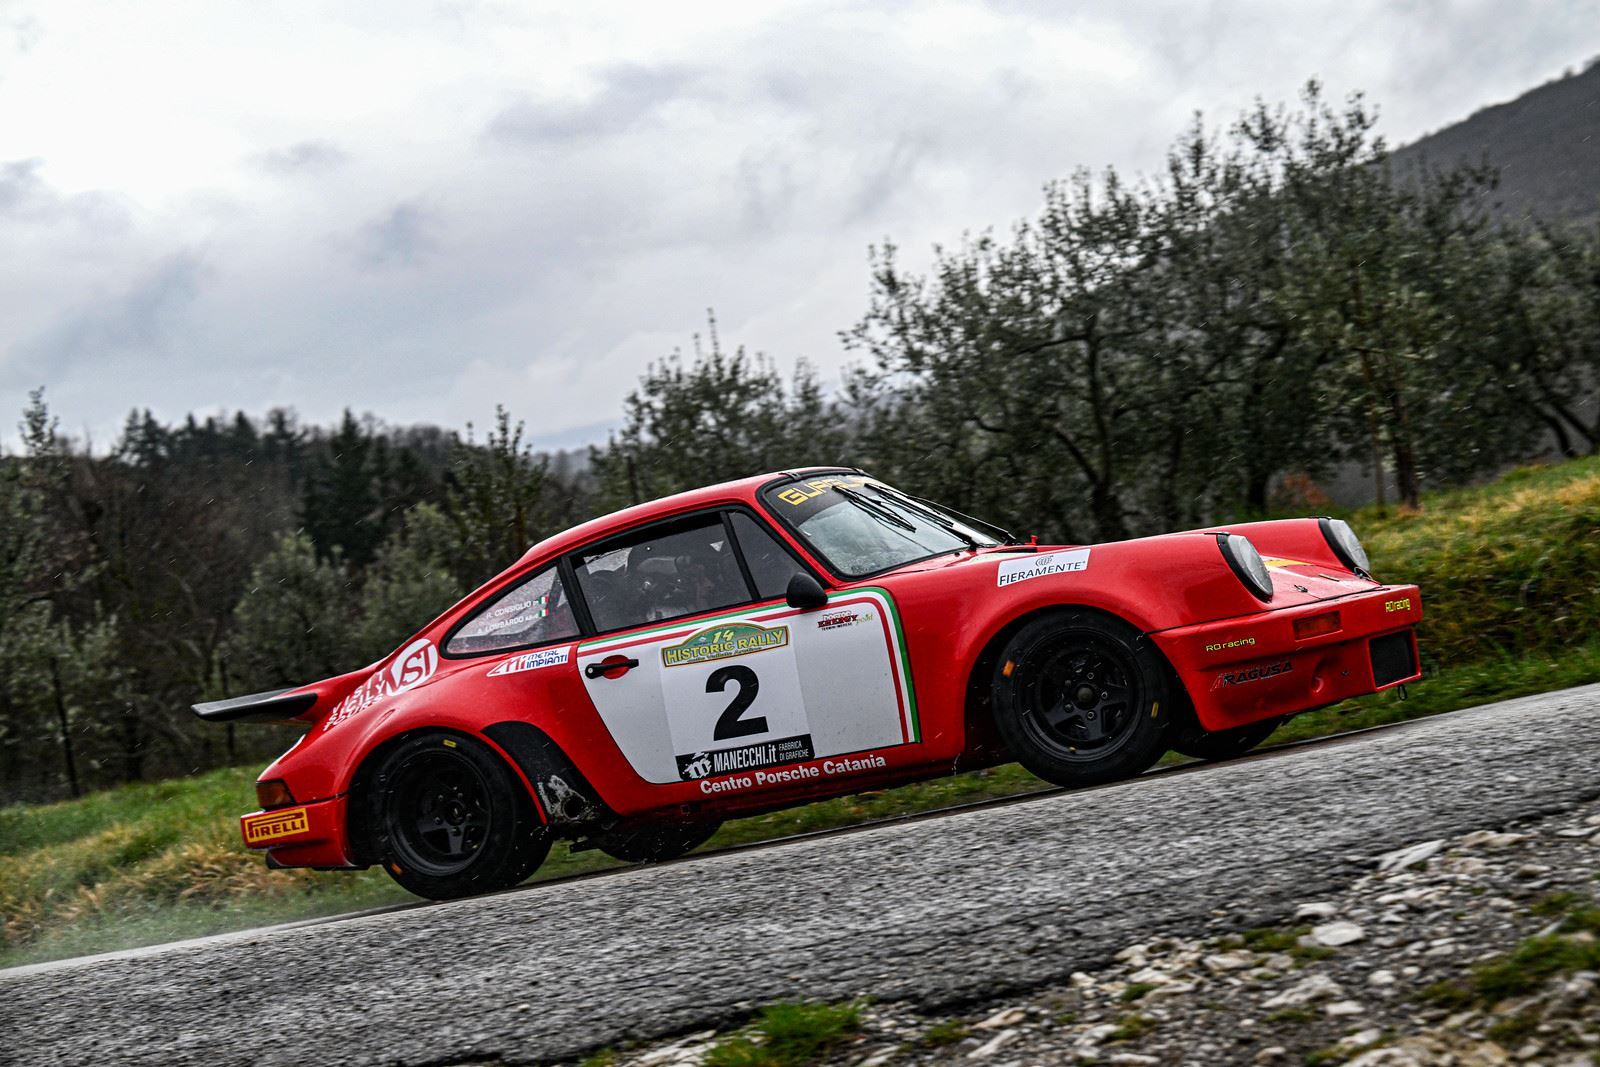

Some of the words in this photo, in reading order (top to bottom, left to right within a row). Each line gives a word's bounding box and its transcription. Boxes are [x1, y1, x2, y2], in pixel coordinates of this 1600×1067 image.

[494, 600, 532, 617] CONSIGLIO
[485, 615, 525, 633] LOMBARDO
[711, 629, 735, 644] 14
[527, 650, 559, 660] METAL
[666, 641, 735, 664] HISTORIC
[738, 630, 784, 650] RALLY
[526, 654, 568, 669] IMPIANTI
[1222, 660, 1294, 688] RAGUSA
[328, 680, 386, 723] SICILY
[333, 668, 387, 714] VISIT
[705, 664, 769, 742] 2
[713, 743, 777, 773] MANECCHI.it
[778, 740, 803, 752] FABBRICA
[785, 749, 810, 761] GRAFICHE
[700, 776, 752, 795] Centro
[755, 765, 820, 785] Porsche
[823, 754, 887, 775] Catania
[246, 811, 306, 839] PIRELLI
